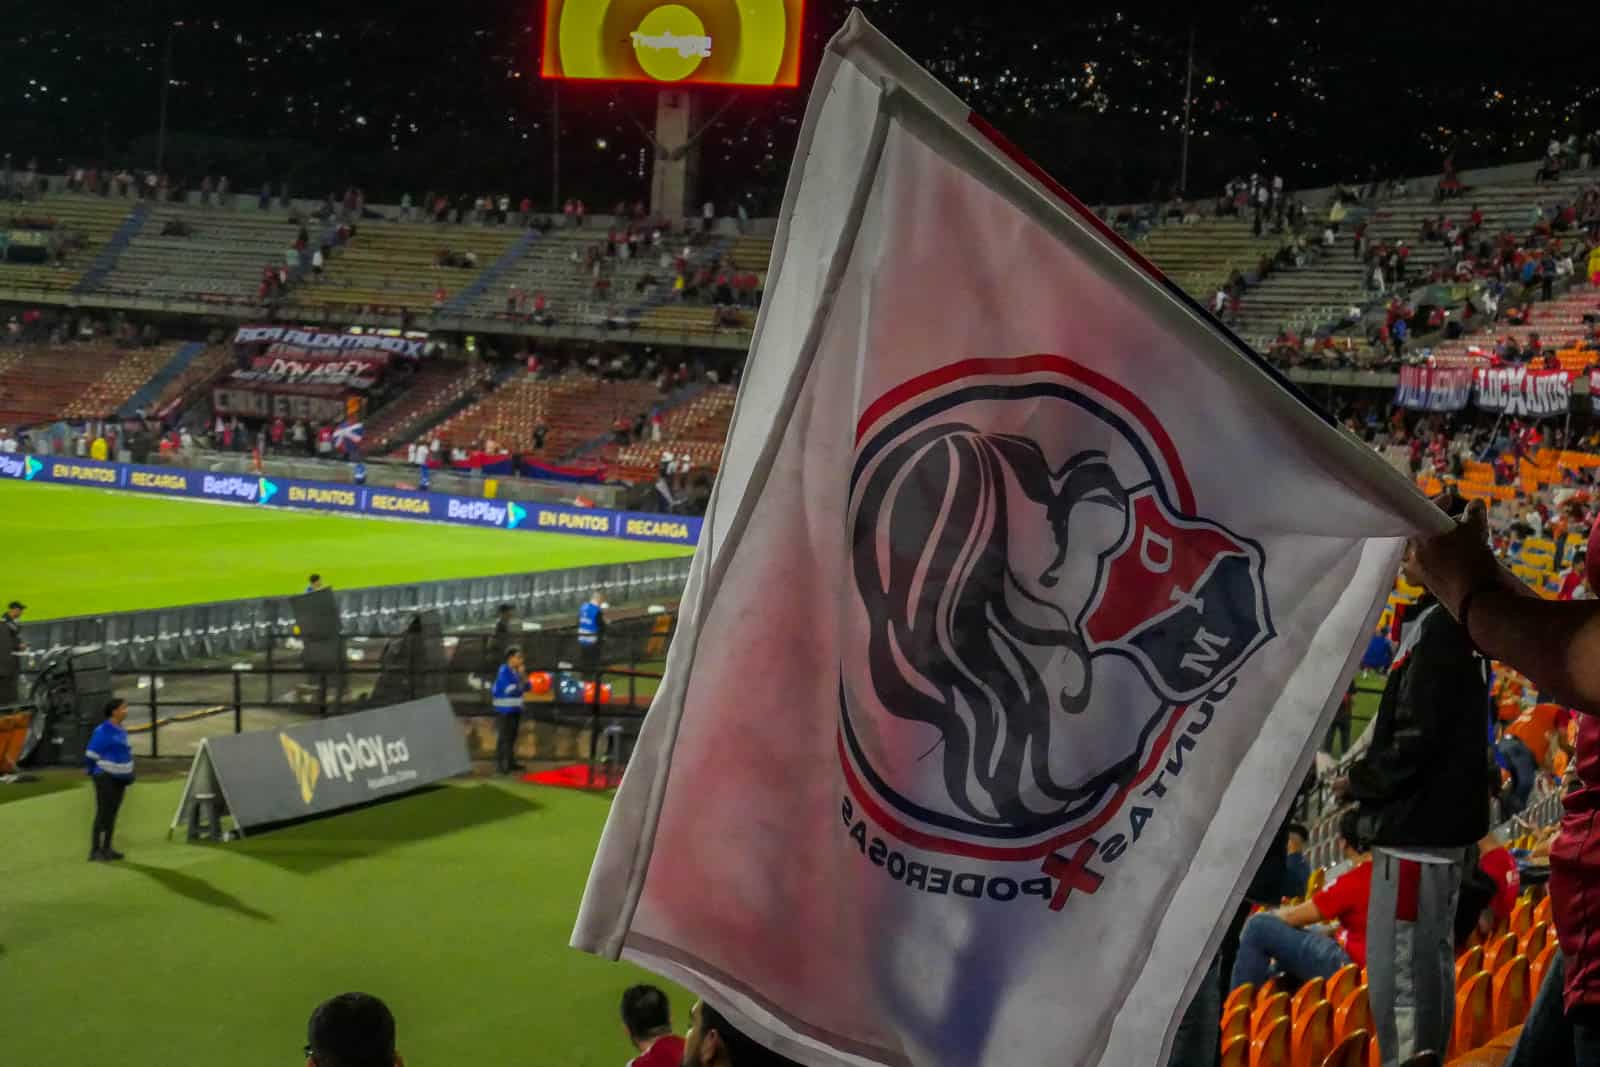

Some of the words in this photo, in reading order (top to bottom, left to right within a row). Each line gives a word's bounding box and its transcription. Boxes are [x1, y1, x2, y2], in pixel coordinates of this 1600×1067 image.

[53, 464, 69, 479] EN
[71, 466, 116, 483] PUNTOS
[131, 472, 187, 490] RECARGA
[203, 475, 258, 500] BetPlay
[289, 486, 305, 501] EN
[307, 488, 355, 506] PUNTOS
[371, 495, 430, 514] RECARGA
[448, 498, 506, 525] BetPlay
[539, 511, 557, 527] EN
[558, 512, 609, 532] PUNTOS
[627, 519, 689, 538] RECARGA
